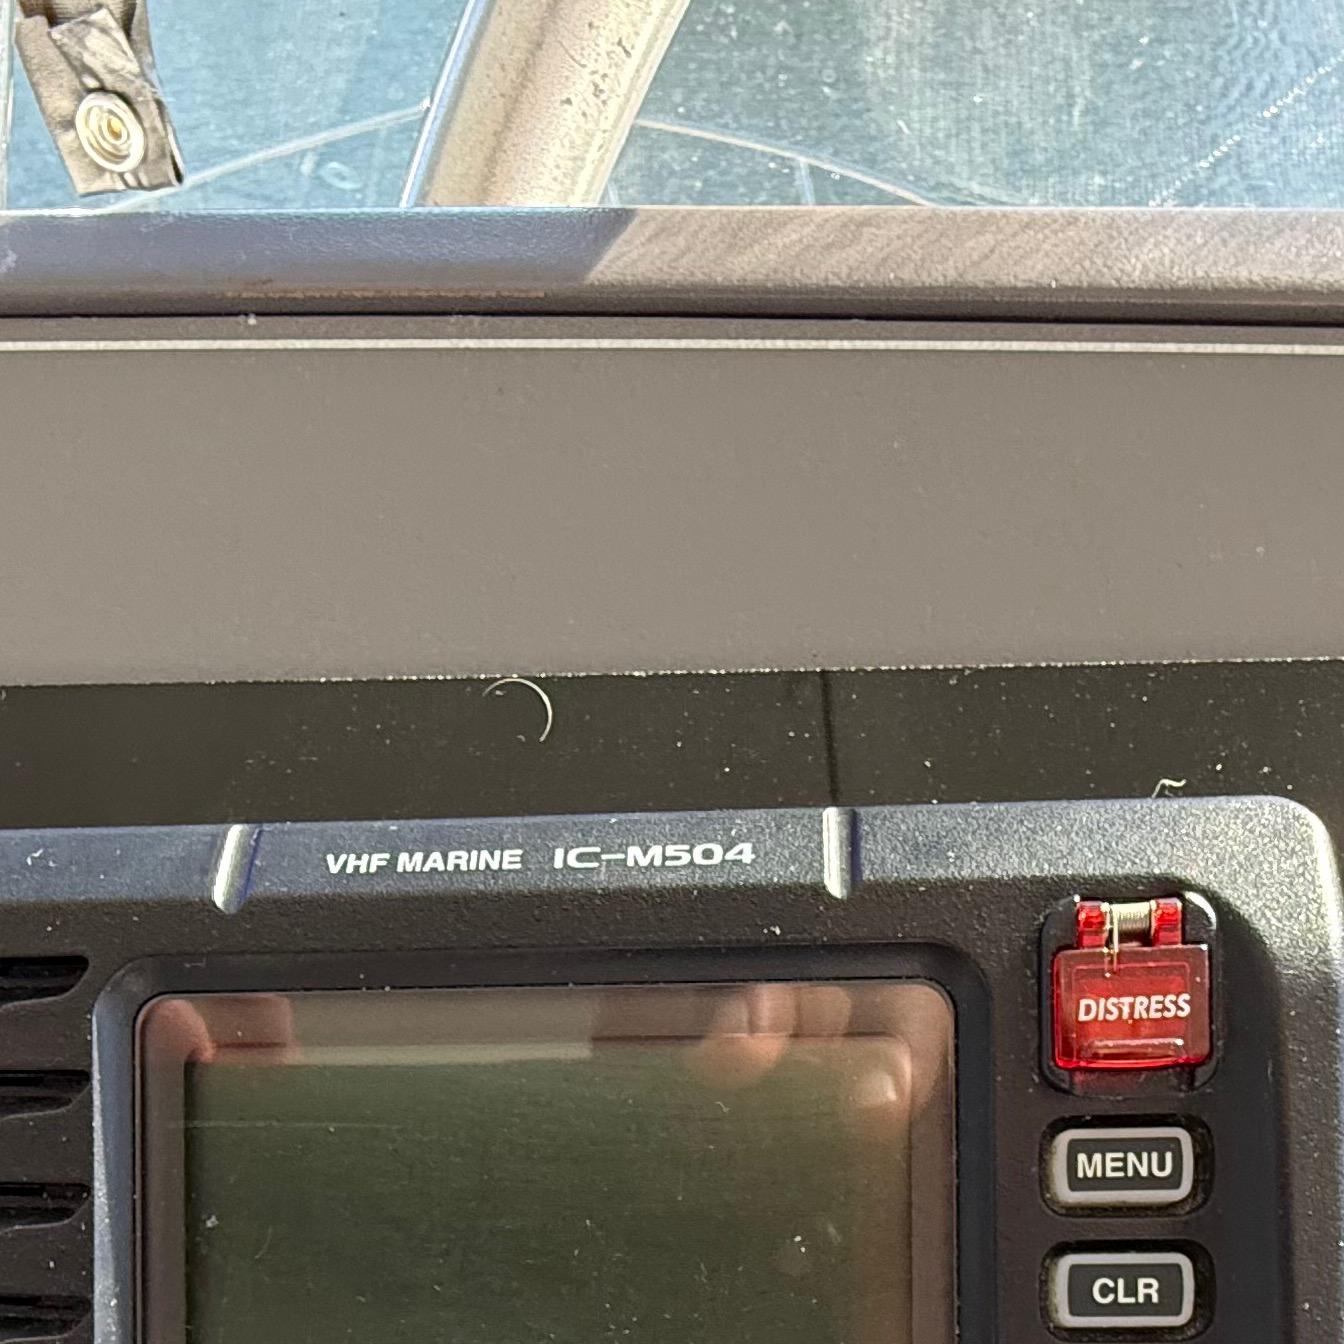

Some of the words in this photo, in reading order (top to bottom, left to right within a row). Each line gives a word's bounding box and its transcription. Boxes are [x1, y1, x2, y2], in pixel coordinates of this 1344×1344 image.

[325, 853, 389, 875] VHF
[396, 849, 524, 873] MARINE
[553, 842, 756, 869] IC-M504
[1077, 993, 1192, 1022] DISTRESS
[1076, 1151, 1174, 1179] MENU
[1091, 1277, 1160, 1304] CLR
